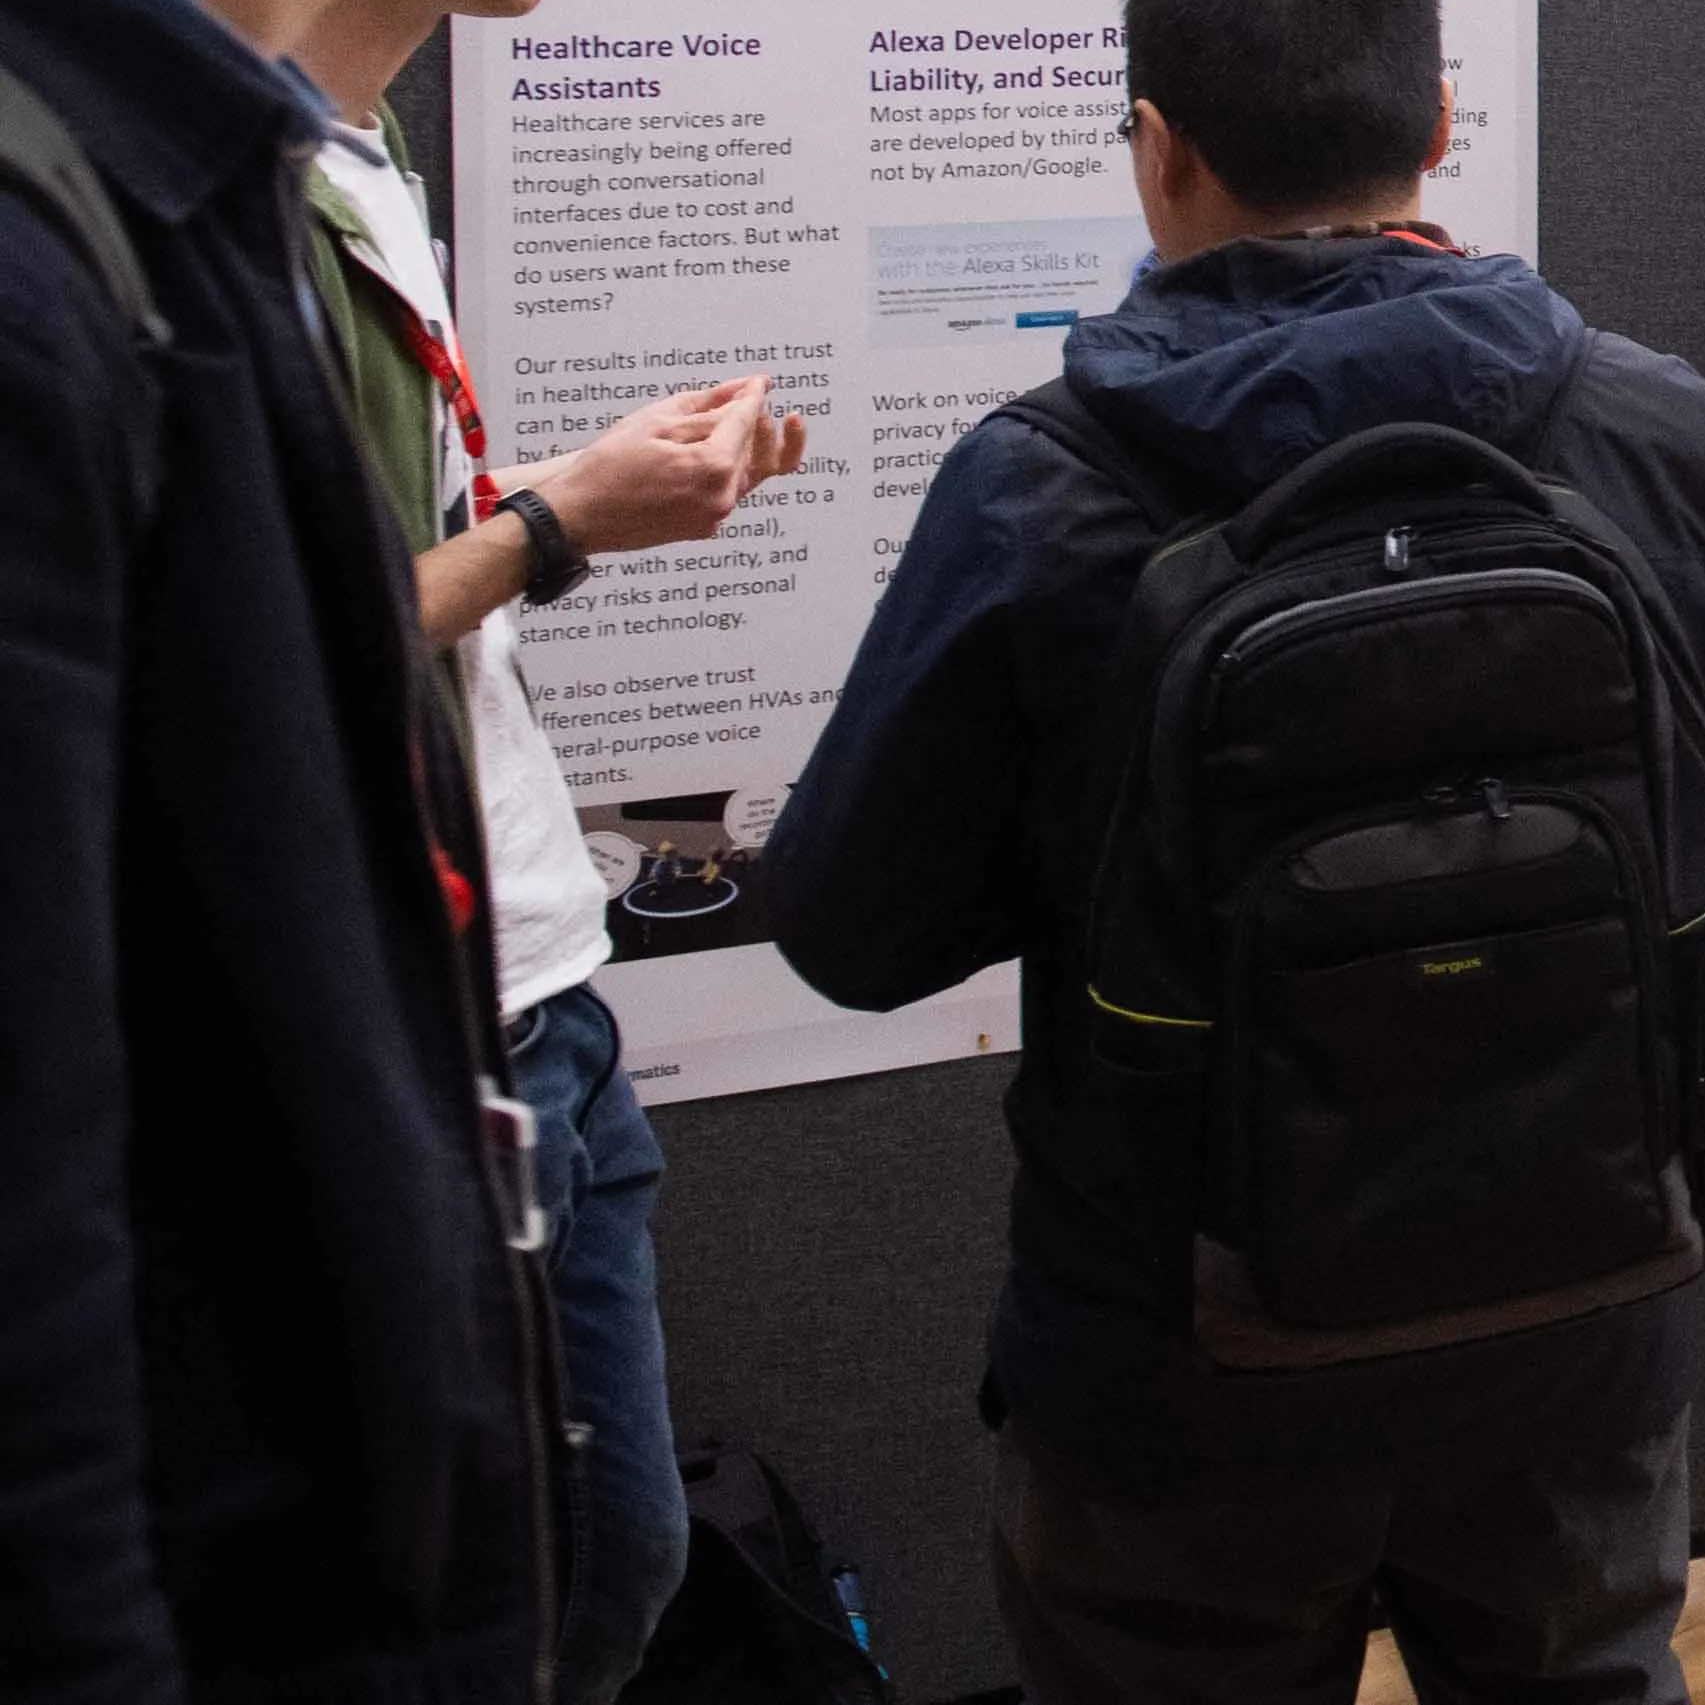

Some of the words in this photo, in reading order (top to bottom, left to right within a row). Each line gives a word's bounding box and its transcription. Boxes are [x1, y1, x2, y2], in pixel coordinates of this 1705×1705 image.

[512, 34, 673, 60] Healthcare
[683, 32, 760, 57] Voice
[869, 29, 944, 53] Alexa
[955, 27, 1093, 54] Developer
[512, 76, 660, 101] Assistants
[871, 67, 984, 95] Liability,
[993, 65, 1042, 89] and
[1052, 66, 1125, 88] Secur
[512, 113, 632, 133] Healthcare
[640, 111, 725, 130] services
[731, 113, 765, 128] are
[870, 106, 922, 123] Most
[929, 107, 976, 125] apps
[982, 101, 1011, 120] for
[1016, 101, 1068, 119] voice
[513, 142, 642, 165] increasingly
[650, 141, 709, 162] being
[716, 137, 792, 158] offered
[870, 138, 902, 153] are
[909, 130, 1014, 152] developed
[1022, 129, 1045, 151] by
[1051, 128, 1096, 146] third
[512, 174, 600, 197] through
[608, 167, 764, 191] conversational
[871, 165, 904, 181] not
[912, 162, 935, 183] by
[941, 156, 1107, 179] Amazon/Google.
[514, 203, 622, 225] interfaces
[628, 201, 669, 220] due
[676, 202, 698, 218] to
[705, 200, 748, 217] cost
[754, 195, 793, 215] and
[513, 234, 651, 256] convenience
[658, 229, 737, 248] factors.
[745, 227, 780, 245] But
[787, 224, 840, 243] what
[514, 266, 542, 285] do
[550, 267, 607, 284] users
[613, 262, 668, 280] want
[674, 259, 725, 277] from
[732, 256, 790, 274] these
[962, 257, 1015, 275] Alexa
[1021, 253, 1069, 272] Skills
[1075, 252, 1100, 269] Kit
[514, 292, 614, 319] systems?
[515, 357, 557, 376] Our
[564, 351, 636, 372] results
[644, 348, 728, 369] indicate
[734, 344, 777, 363] that
[784, 342, 833, 360] trust
[516, 388, 535, 405] in
[543, 383, 659, 403] healthcare
[872, 392, 927, 412] Work
[934, 394, 958, 408] on
[516, 419, 553, 435] can
[562, 414, 588, 432] be
[873, 423, 945, 445] privacy
[796, 489, 817, 505] to
[823, 491, 835, 504] a
[620, 555, 667, 576] with
[674, 550, 762, 572] security,
[769, 545, 807, 564] and
[604, 587, 652, 607] risks
[658, 581, 698, 603] and
[705, 575, 795, 602] personal
[520, 625, 590, 644] stance
[598, 620, 616, 637] in
[624, 612, 746, 635] technology.
[563, 679, 607, 700] also
[613, 674, 699, 695] observe
[704, 666, 756, 686] trust
[542, 708, 642, 730] fferences
[649, 698, 741, 720] between
[750, 690, 802, 710] HVAs
[706, 723, 761, 743] voice
[1422, 956, 1482, 975] Targus
